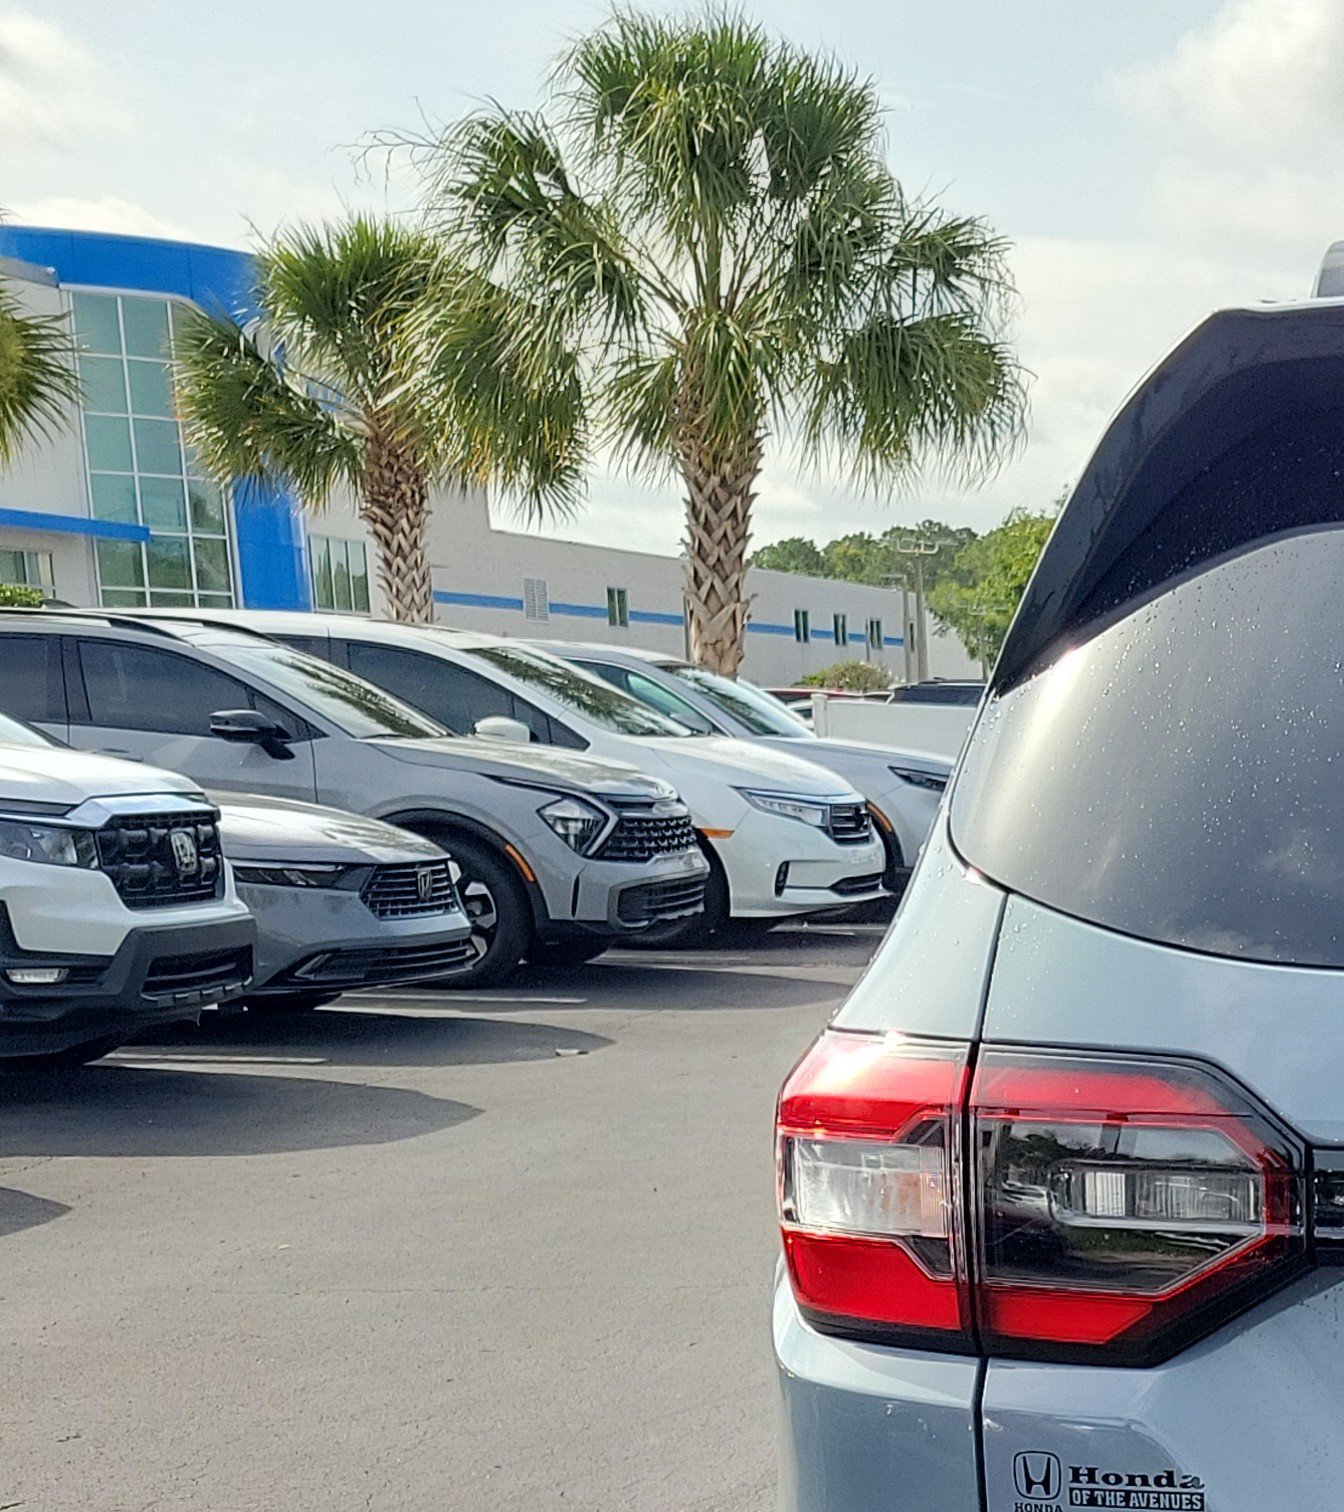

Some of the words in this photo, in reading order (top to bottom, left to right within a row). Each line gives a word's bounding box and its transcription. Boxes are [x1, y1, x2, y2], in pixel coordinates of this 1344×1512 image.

[1068, 1466, 1205, 1489] Honda
[1072, 1489, 1091, 1505] OF
[1094, 1491, 1126, 1507] THE
[1129, 1493, 1203, 1510] AVENUES
